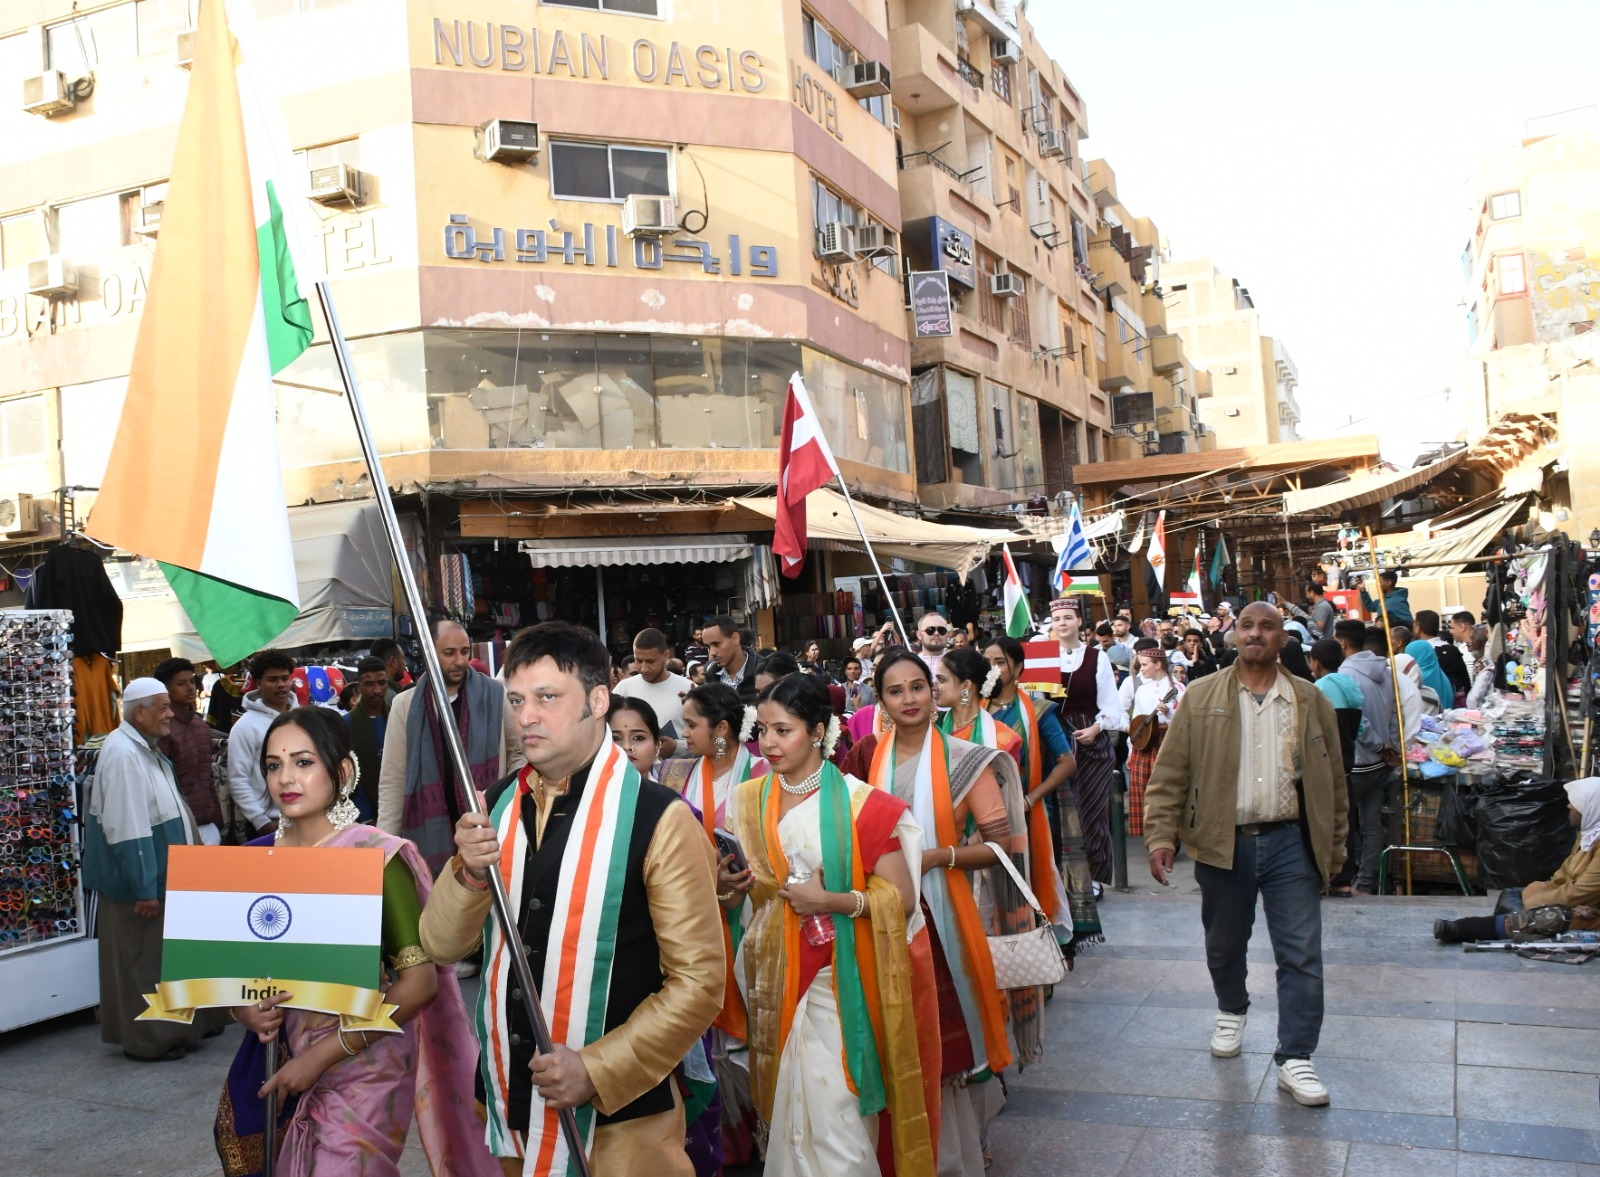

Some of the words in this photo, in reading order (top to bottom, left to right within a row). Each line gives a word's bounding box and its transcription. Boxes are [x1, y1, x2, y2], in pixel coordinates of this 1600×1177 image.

[433, 17, 608, 80] NUBIAN
[632, 38, 766, 94] OASIS
[790, 59, 844, 142] HOTEL
[314, 217, 393, 275] TEL
[444, 213, 618, 267] النوبة
[0, 290, 81, 339] BIAN
